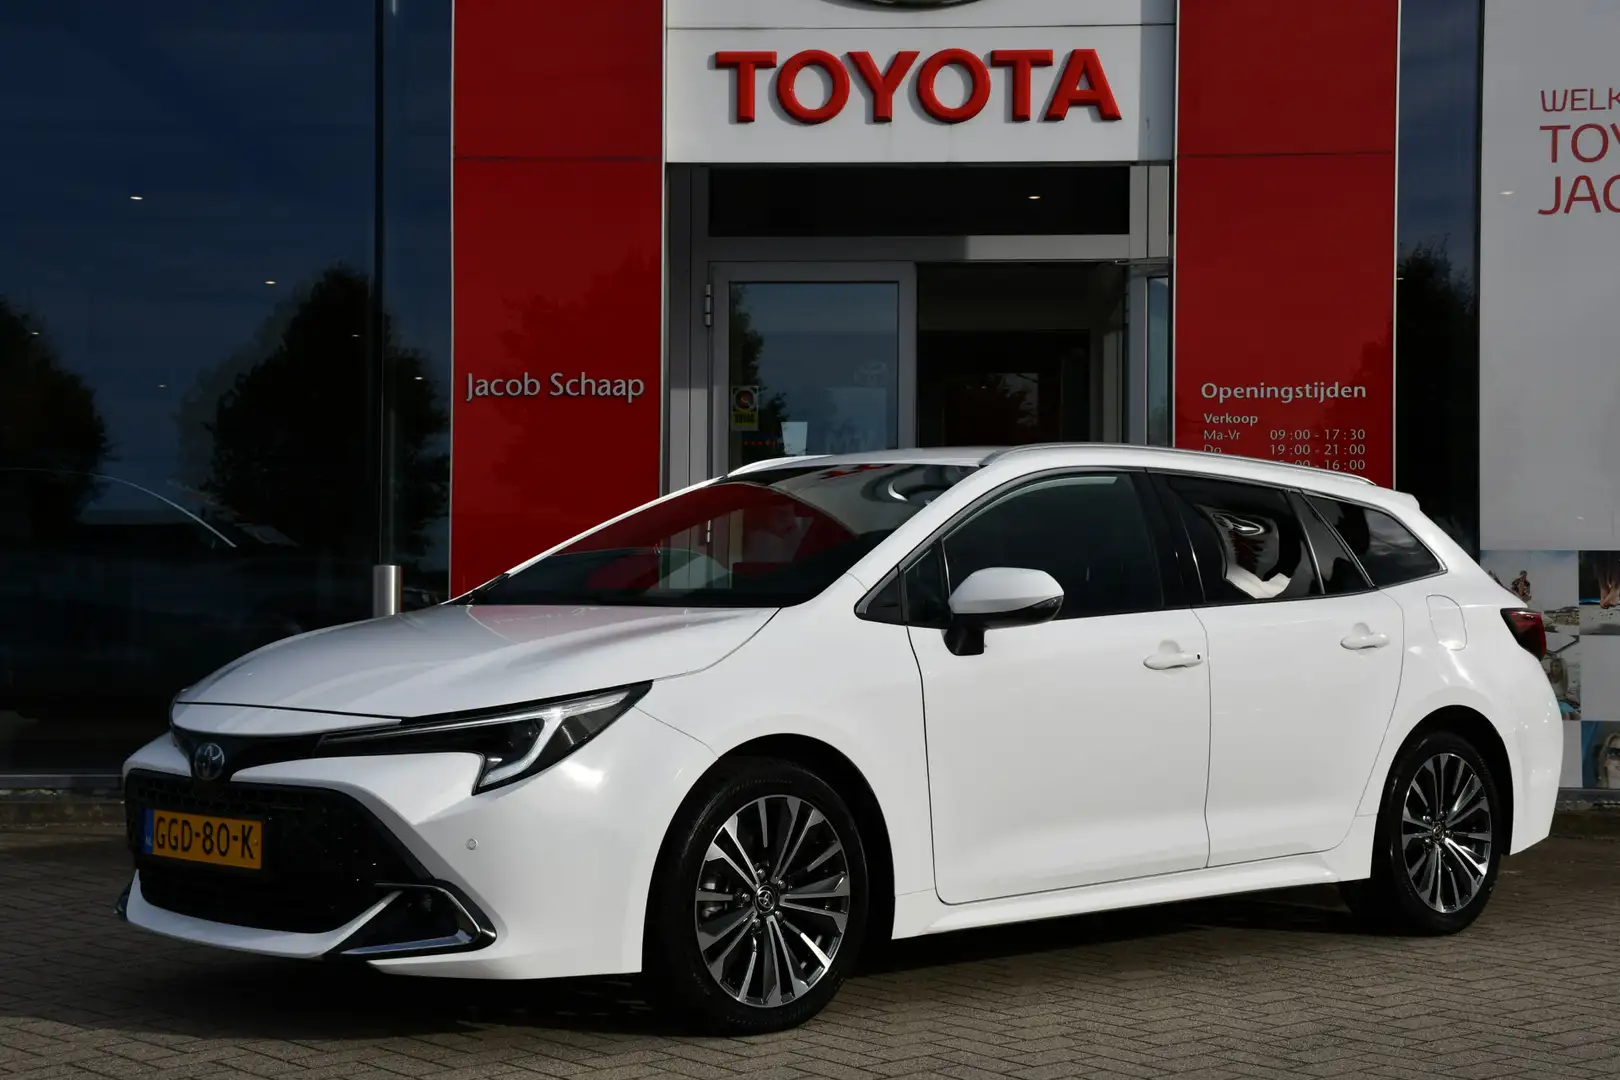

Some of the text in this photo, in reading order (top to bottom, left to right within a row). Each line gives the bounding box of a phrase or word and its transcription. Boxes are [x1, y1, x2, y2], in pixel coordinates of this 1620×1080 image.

[714, 48, 1122, 124] TOYOTA
[466, 372, 645, 403] Jacob Schaap
[1201, 382, 1367, 403] Openingstijden
[1203, 413, 1258, 426] Verkoop
[1203, 429, 1241, 440] Ma-Vr
[155, 816, 254, 859] GGD-80-K
